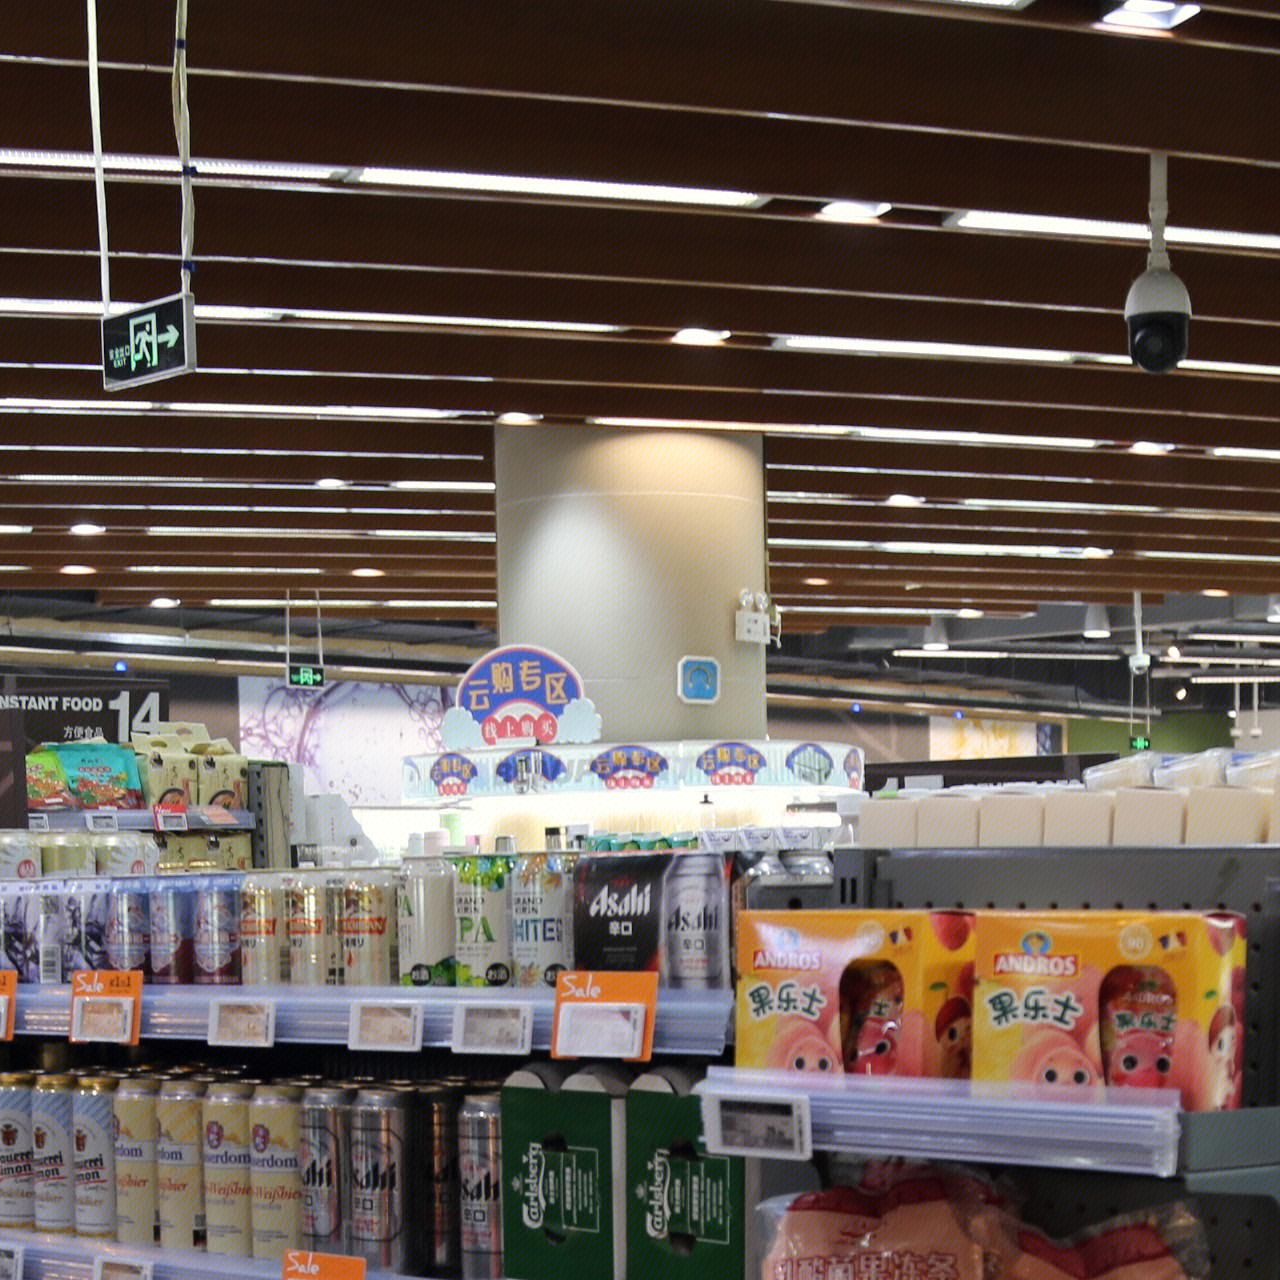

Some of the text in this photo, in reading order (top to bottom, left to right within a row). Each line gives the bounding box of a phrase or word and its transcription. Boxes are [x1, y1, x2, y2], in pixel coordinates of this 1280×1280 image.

[468, 660, 569, 711] 云购专区
[62, 696, 103, 712] FOOD
[109, 690, 161, 742] 14
[63, 725, 104, 740] 方便食品
[484, 714, 556, 740] 线上购买
[589, 883, 652, 918] Asahi
[608, 921, 633, 937] 辛口
[668, 903, 720, 933] Asahi
[682, 938, 706, 951] 辛口
[754, 951, 821, 971] ANDROS
[995, 955, 1076, 977] ANDROS
[75, 974, 105, 993] Sale
[561, 974, 602, 999] Sale
[747, 984, 827, 1018] 果乐士
[987, 989, 1081, 1027] 果乐士
[522, 1142, 547, 1229] Carlsberg
[645, 1148, 672, 1240] Carlsberg
[286, 1252, 320, 1275] Sale
